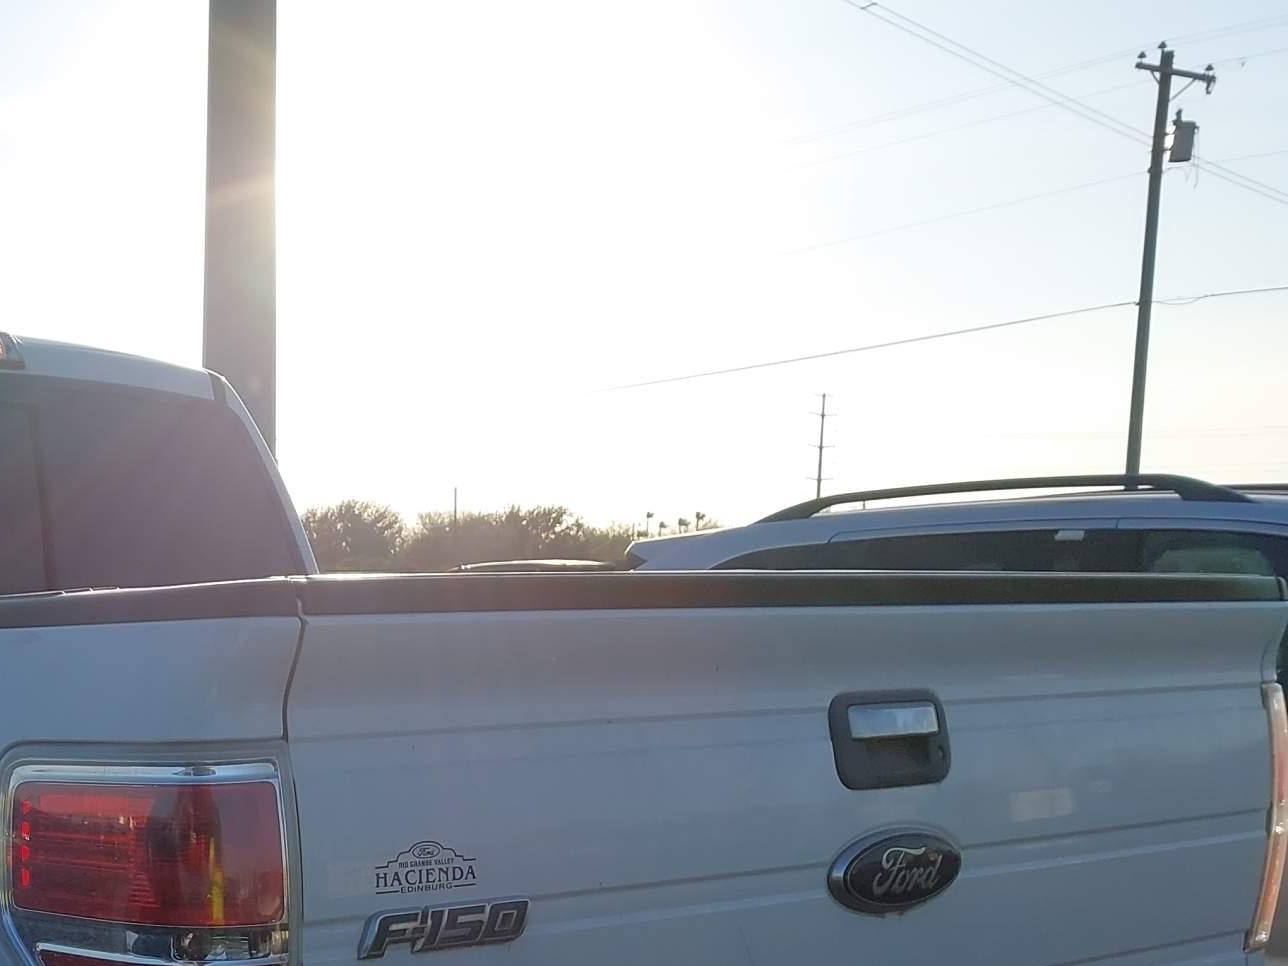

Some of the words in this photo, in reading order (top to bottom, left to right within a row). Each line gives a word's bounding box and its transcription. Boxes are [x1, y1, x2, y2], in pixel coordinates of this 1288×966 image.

[433, 857, 455, 866] VALLEY
[375, 865, 476, 888] HACIENDA
[872, 846, 943, 896] Ford
[400, 881, 454, 893] EDINBURG
